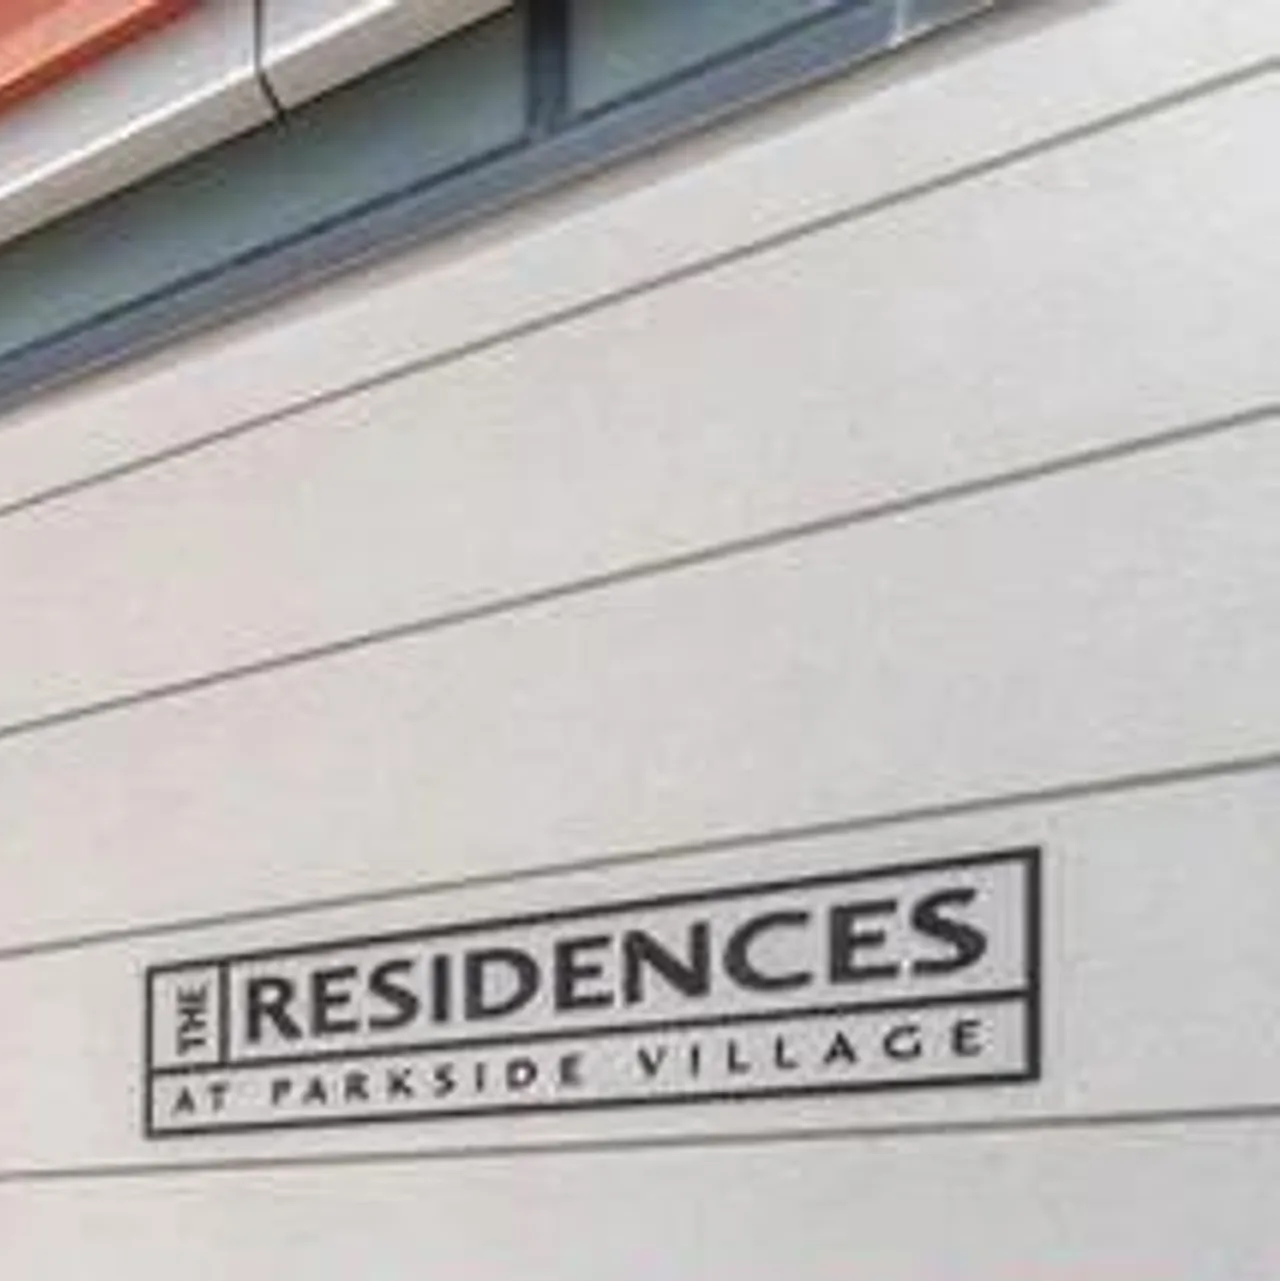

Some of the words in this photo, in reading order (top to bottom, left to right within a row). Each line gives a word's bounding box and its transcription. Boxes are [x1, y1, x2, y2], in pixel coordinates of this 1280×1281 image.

[245, 886, 990, 1043] RESIDENCES
[171, 1081, 230, 1115] AT
[270, 1053, 584, 1107] PARKSIDE
[637, 1018, 985, 1080] VILLAGE
[176, 983, 208, 1057] THE
